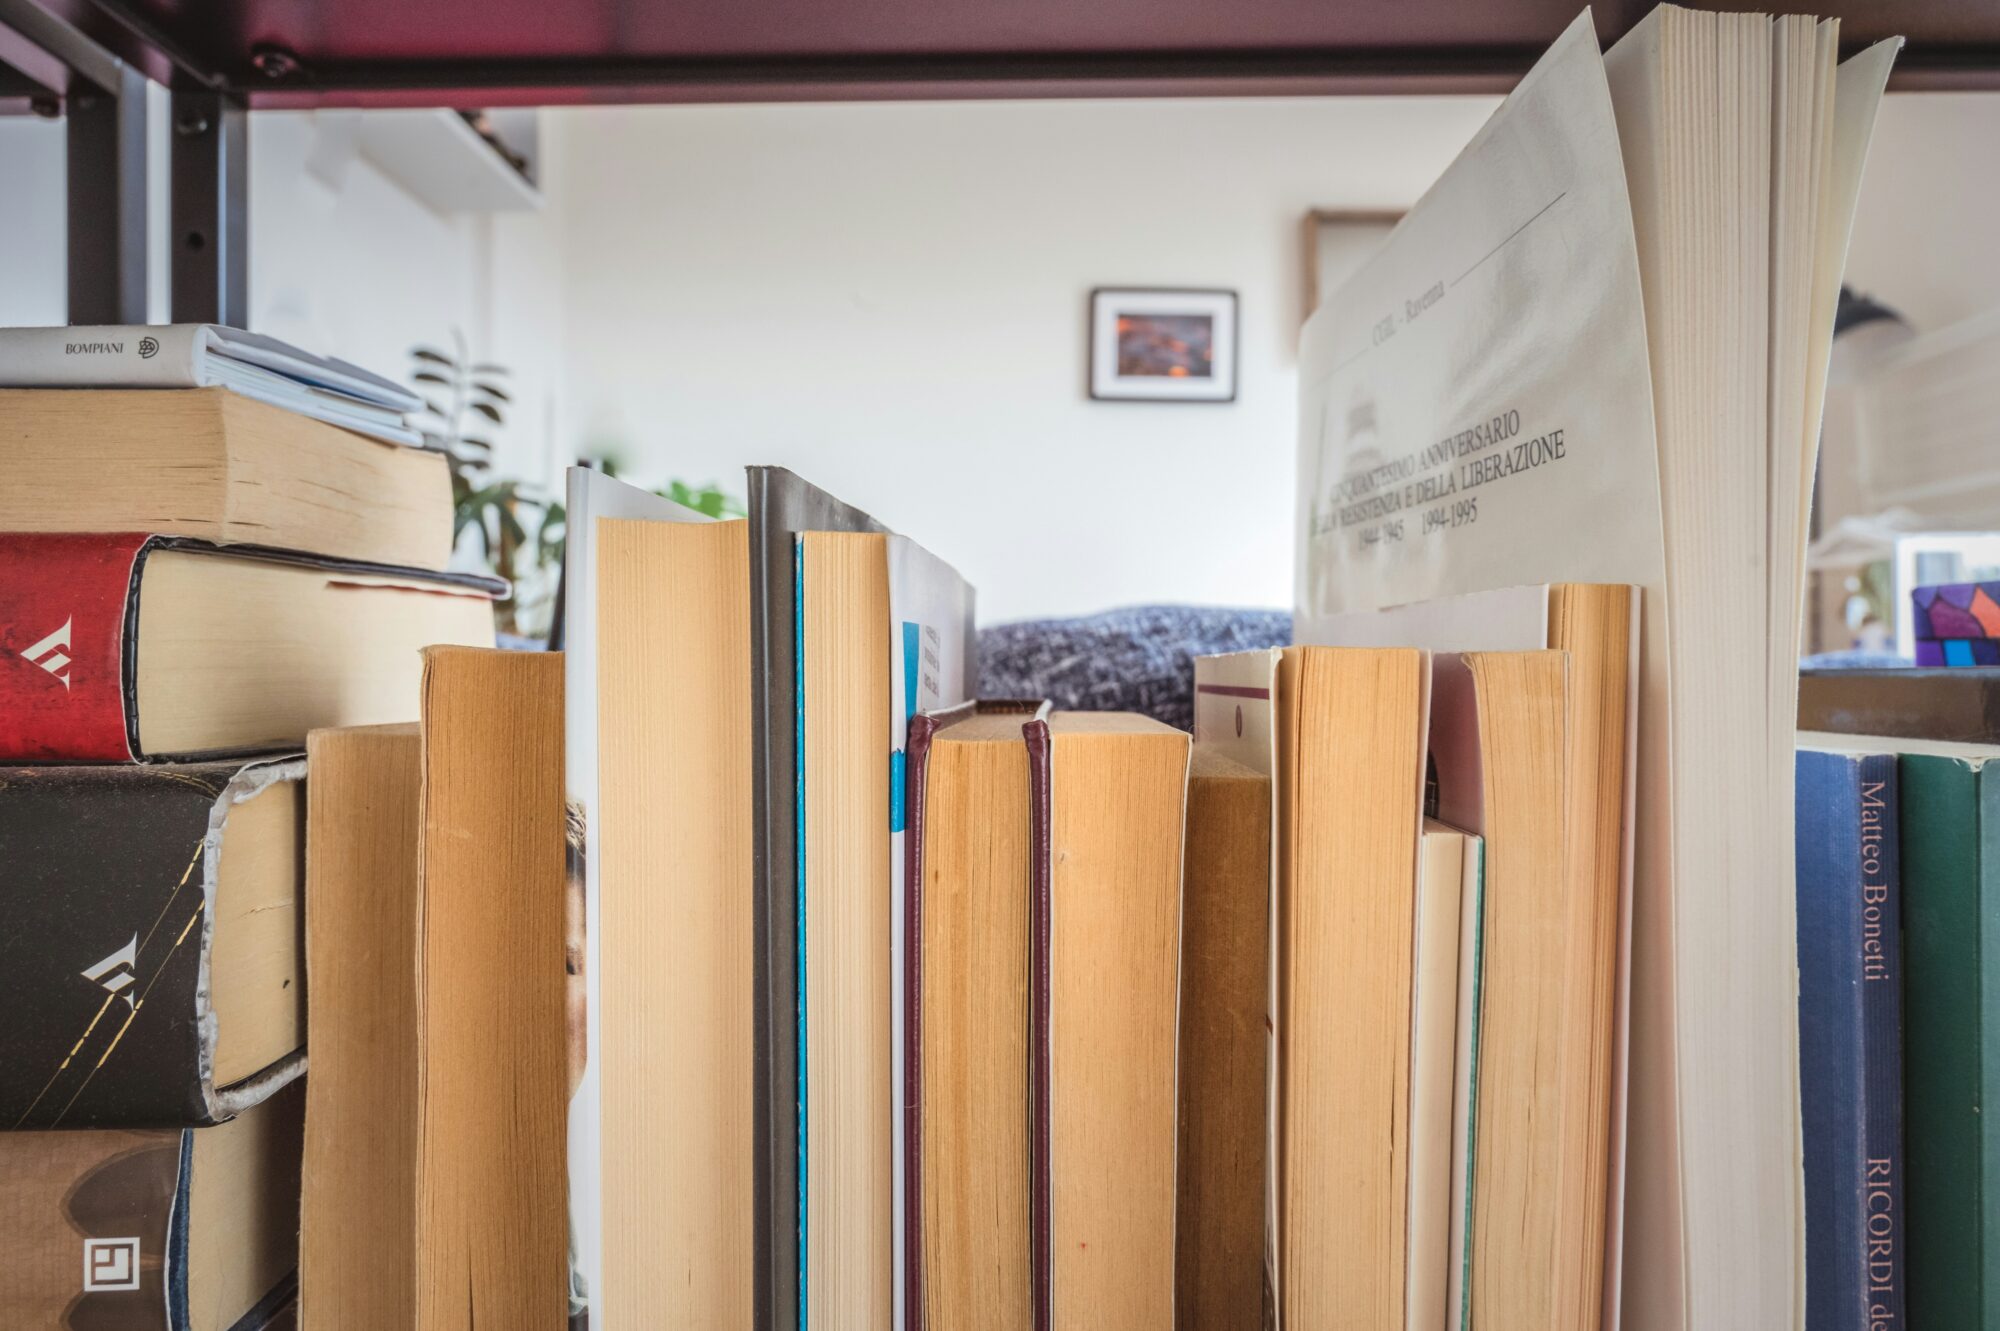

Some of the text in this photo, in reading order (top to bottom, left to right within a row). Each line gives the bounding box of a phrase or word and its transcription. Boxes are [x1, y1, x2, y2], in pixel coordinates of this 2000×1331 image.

[65, 342, 124, 355] BOMPIANI
[1340, 491, 1402, 528] RESISTENZA
[1405, 485, 1414, 508] E
[1416, 470, 1457, 505] DELLA
[1461, 429, 1567, 490] LIBERAZIONE
[1417, 409, 1521, 472] ANNIVERSARIO
[1421, 497, 1478, 536] 1994-1995
[1861, 781, 1890, 980] Matteo Bonetti
[1867, 1155, 1894, 1293] RICORDI
